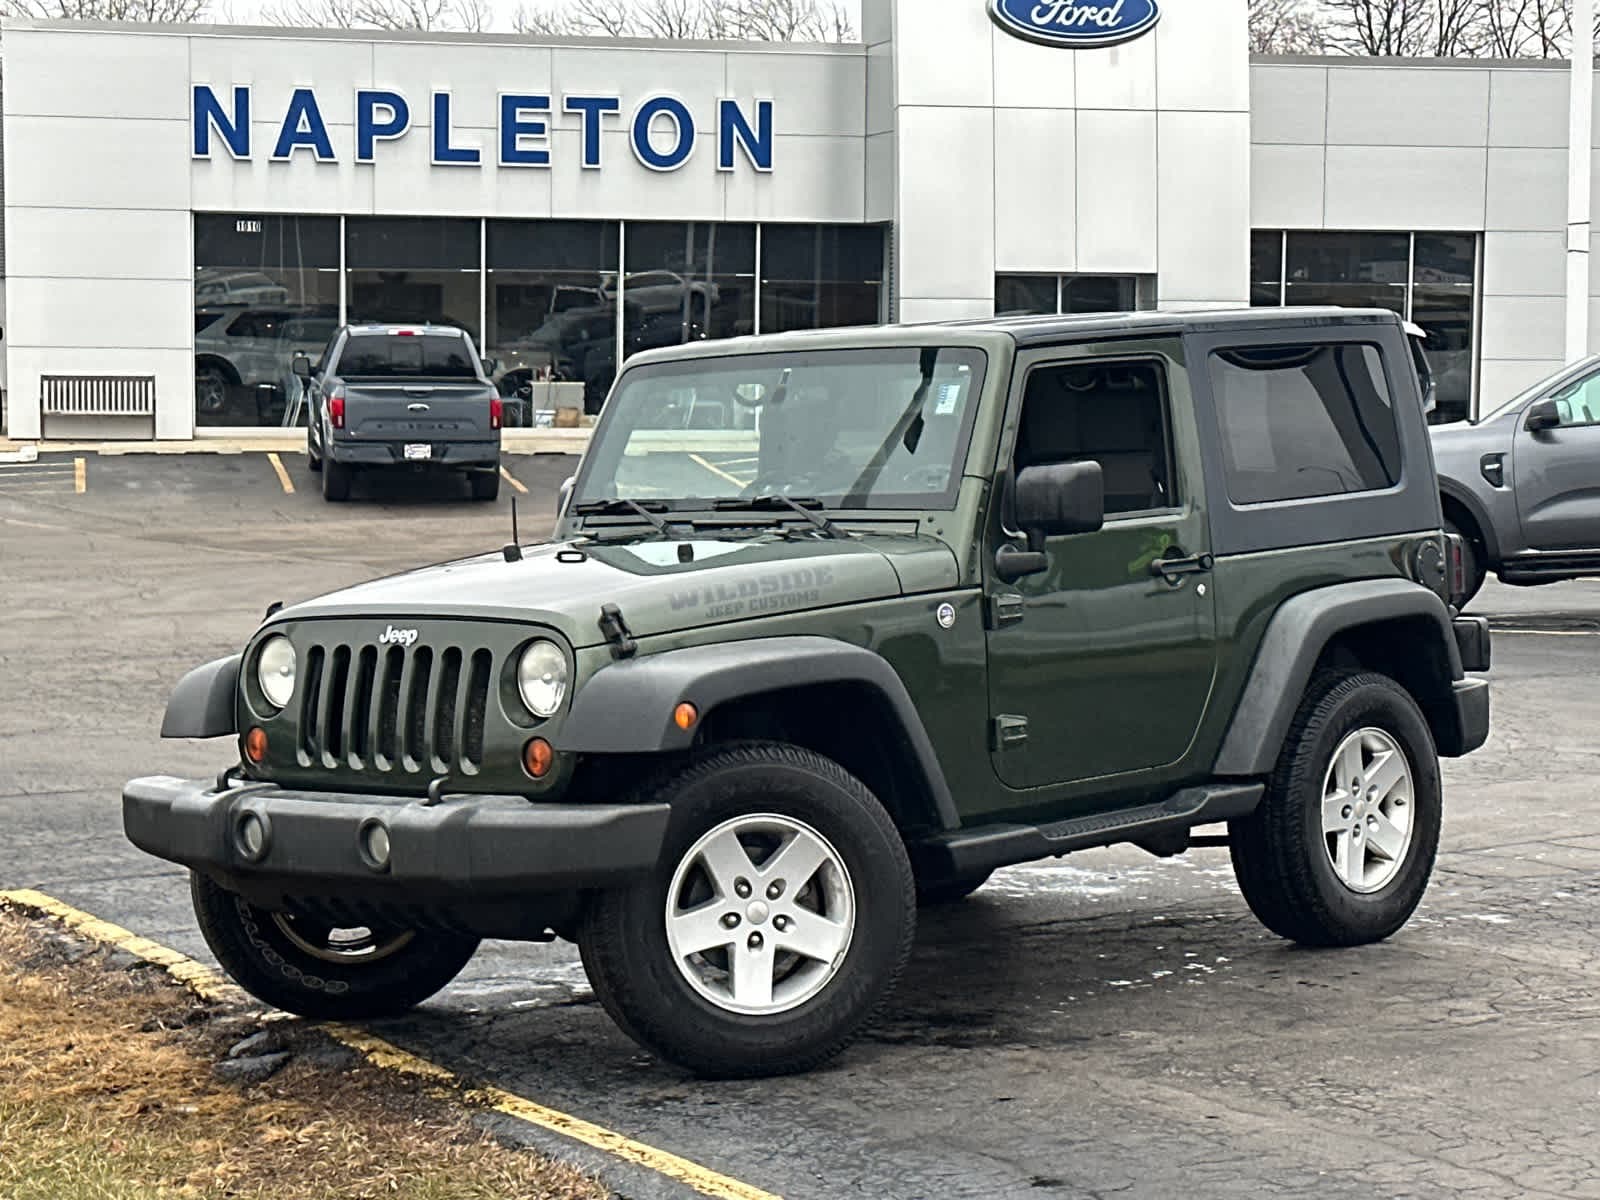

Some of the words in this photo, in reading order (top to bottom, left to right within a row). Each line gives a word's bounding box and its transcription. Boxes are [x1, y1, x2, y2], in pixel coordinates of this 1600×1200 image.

[1031, 0, 1123, 26] Ford
[191, 84, 774, 172] NAPLETON
[237, 220, 261, 232] 1010
[670, 565, 834, 611] WILDSIDE
[704, 601, 745, 618] JEEP
[749, 590, 820, 611] CUSTOMS
[379, 625, 418, 647] Jeep
